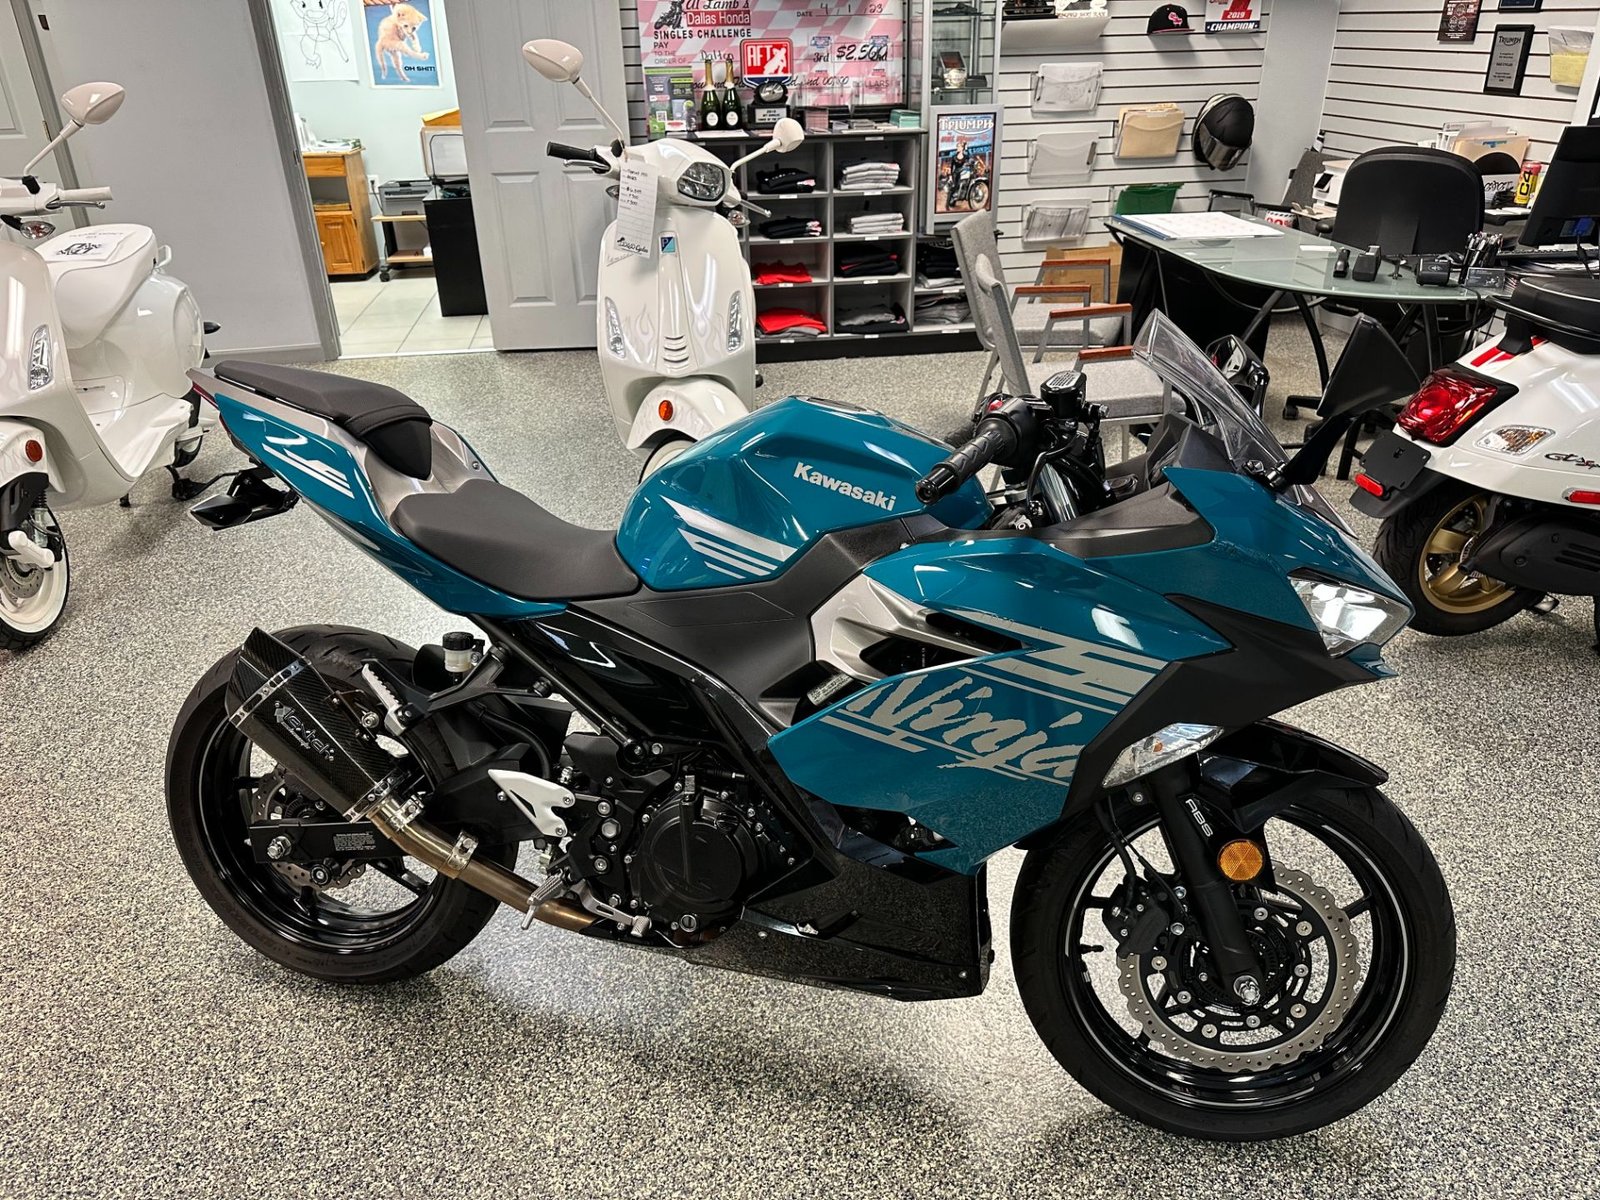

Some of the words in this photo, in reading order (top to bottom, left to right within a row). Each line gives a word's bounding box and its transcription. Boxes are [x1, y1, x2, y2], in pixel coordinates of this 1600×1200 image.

[687, 11, 717, 25] Dallas
[719, 9, 750, 24] Honda
[1227, 11, 1245, 19] 2019
[653, 29, 693, 39] SINGLES
[697, 28, 752, 38] CHALLENGE
[1210, 22, 1255, 31] CHAMPION
[653, 41, 669, 49] PAY
[1498, 35, 1522, 46] TRIUMPH
[747, 45, 774, 67] AFT
[813, 53, 829, 62] 3rd
[938, 117, 994, 131] TRIUMPH
[1520, 170, 1533, 195] C4
[793, 461, 897, 511] Kawasaki
[846, 674, 1085, 778] Ninja
[1185, 798, 1214, 837] ABS
